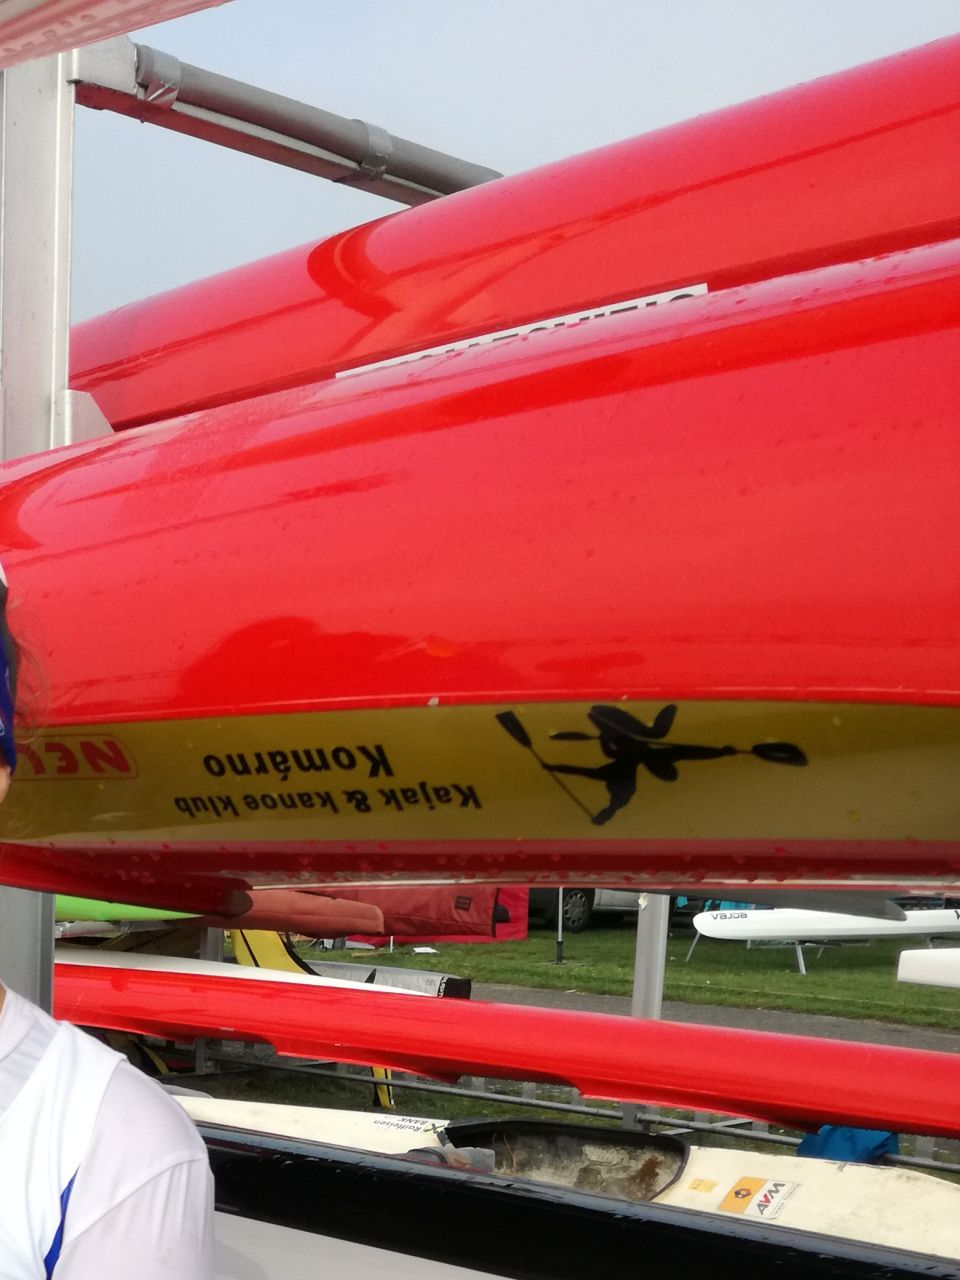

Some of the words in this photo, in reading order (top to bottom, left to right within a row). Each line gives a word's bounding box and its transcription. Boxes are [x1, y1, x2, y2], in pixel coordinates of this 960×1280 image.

[203, 744, 394, 781] Komárno
[174, 795, 240, 818] klub
[244, 791, 339, 814] kanoe
[342, 790, 372, 813] &
[378, 781, 482, 811] Kajak
[374, 1119, 422, 1133] Raiffeisen
[398, 1117, 428, 1126] BANK
[756, 1182, 786, 1215] AVM
